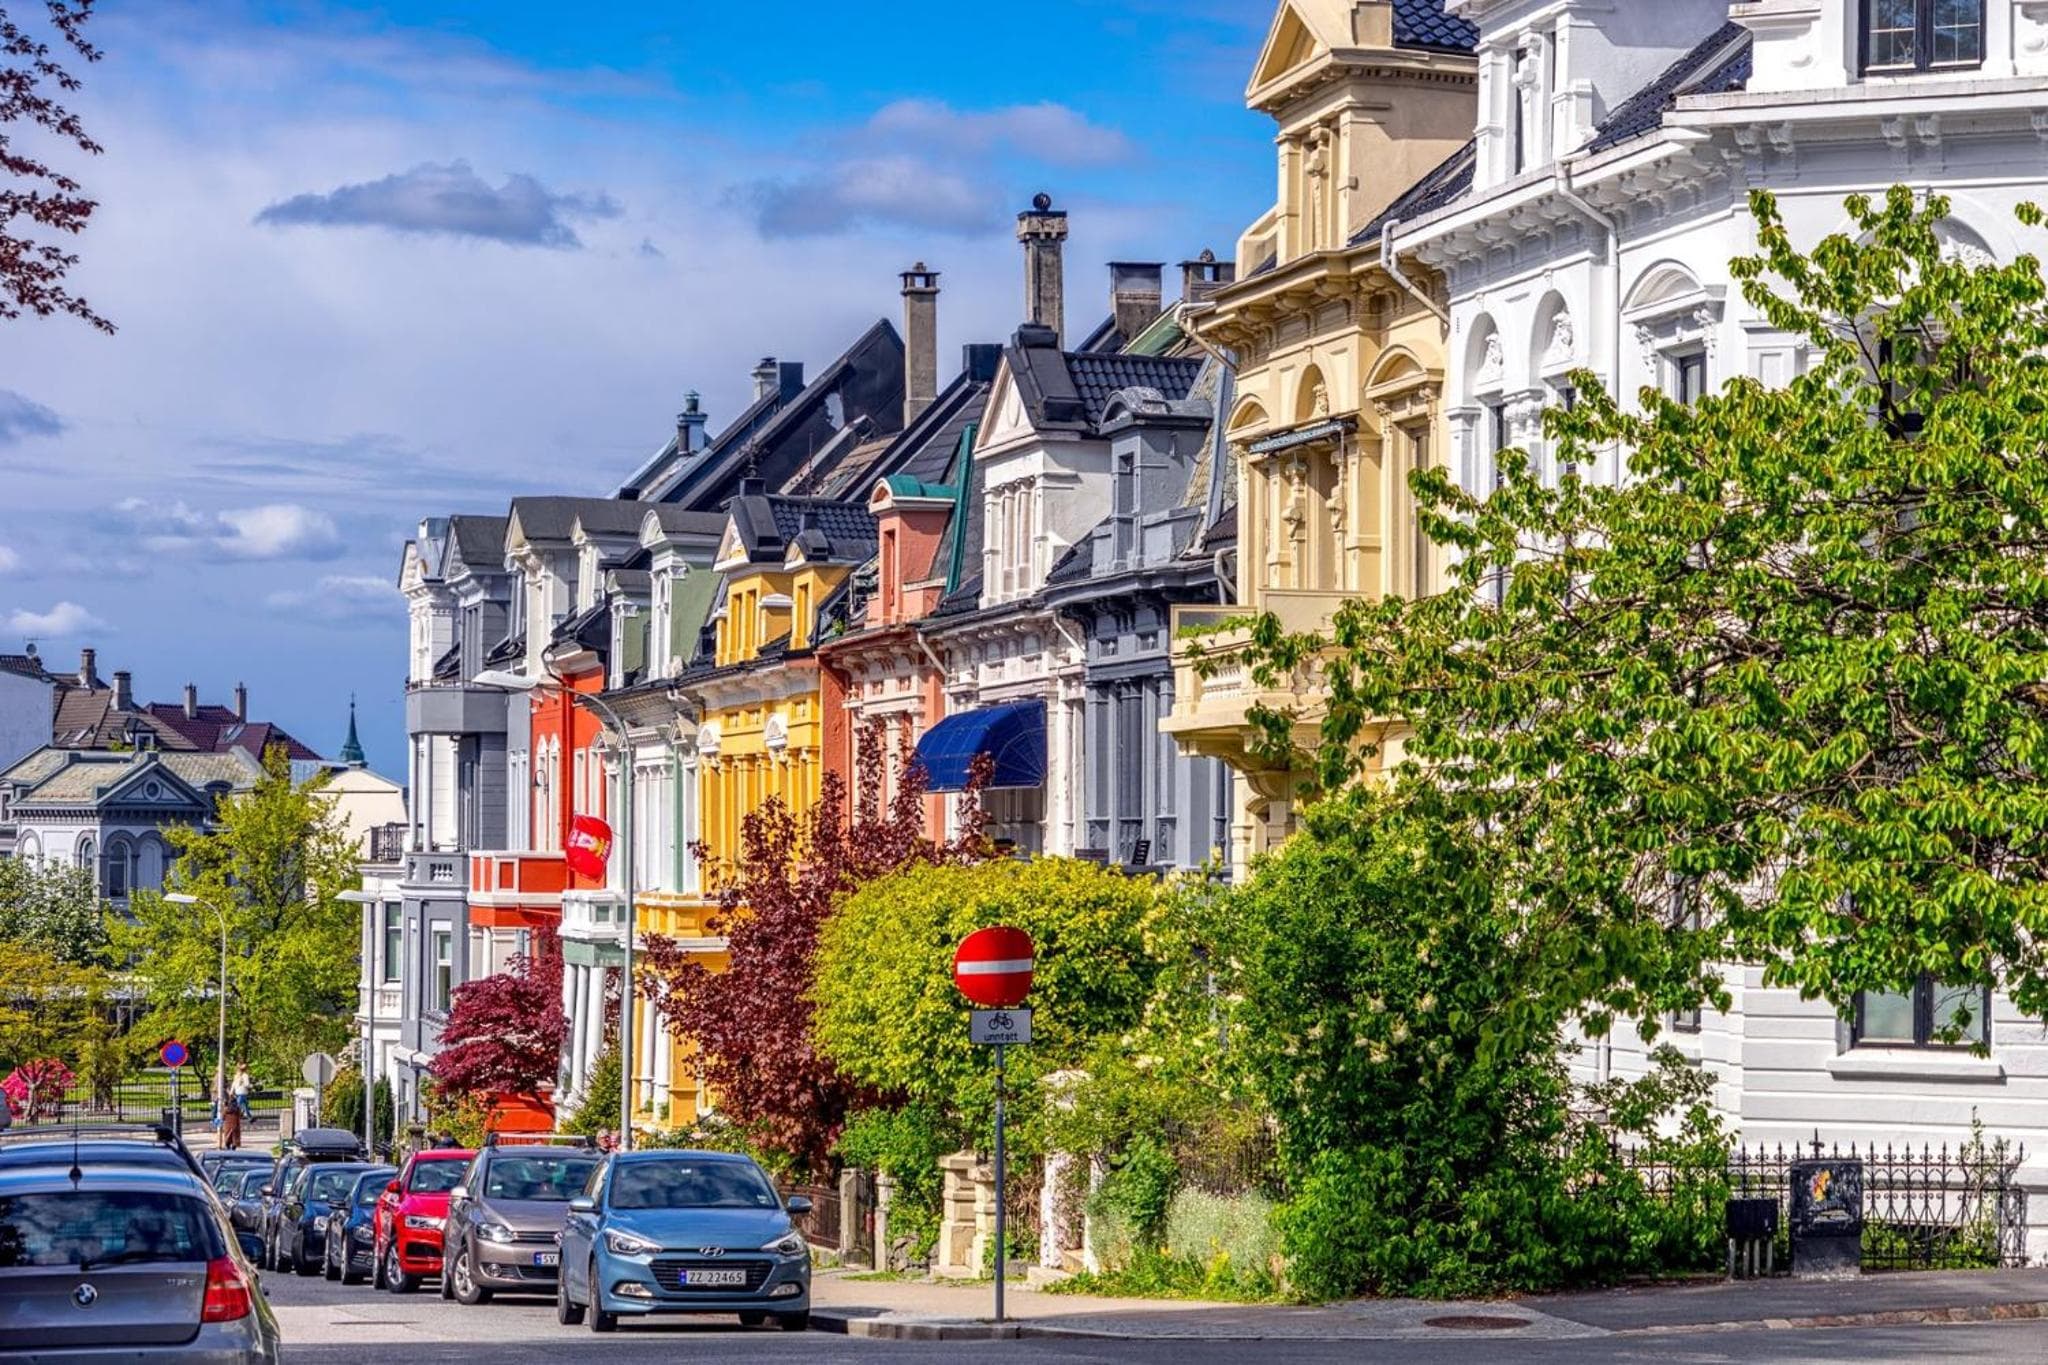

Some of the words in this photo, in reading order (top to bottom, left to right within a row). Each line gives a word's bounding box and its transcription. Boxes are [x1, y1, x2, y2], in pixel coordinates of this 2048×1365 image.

[984, 1033, 1018, 1041] unntatt
[543, 1255, 556, 1264] SV
[689, 1272, 703, 1282] ZZ
[707, 1272, 742, 1282] 22465
